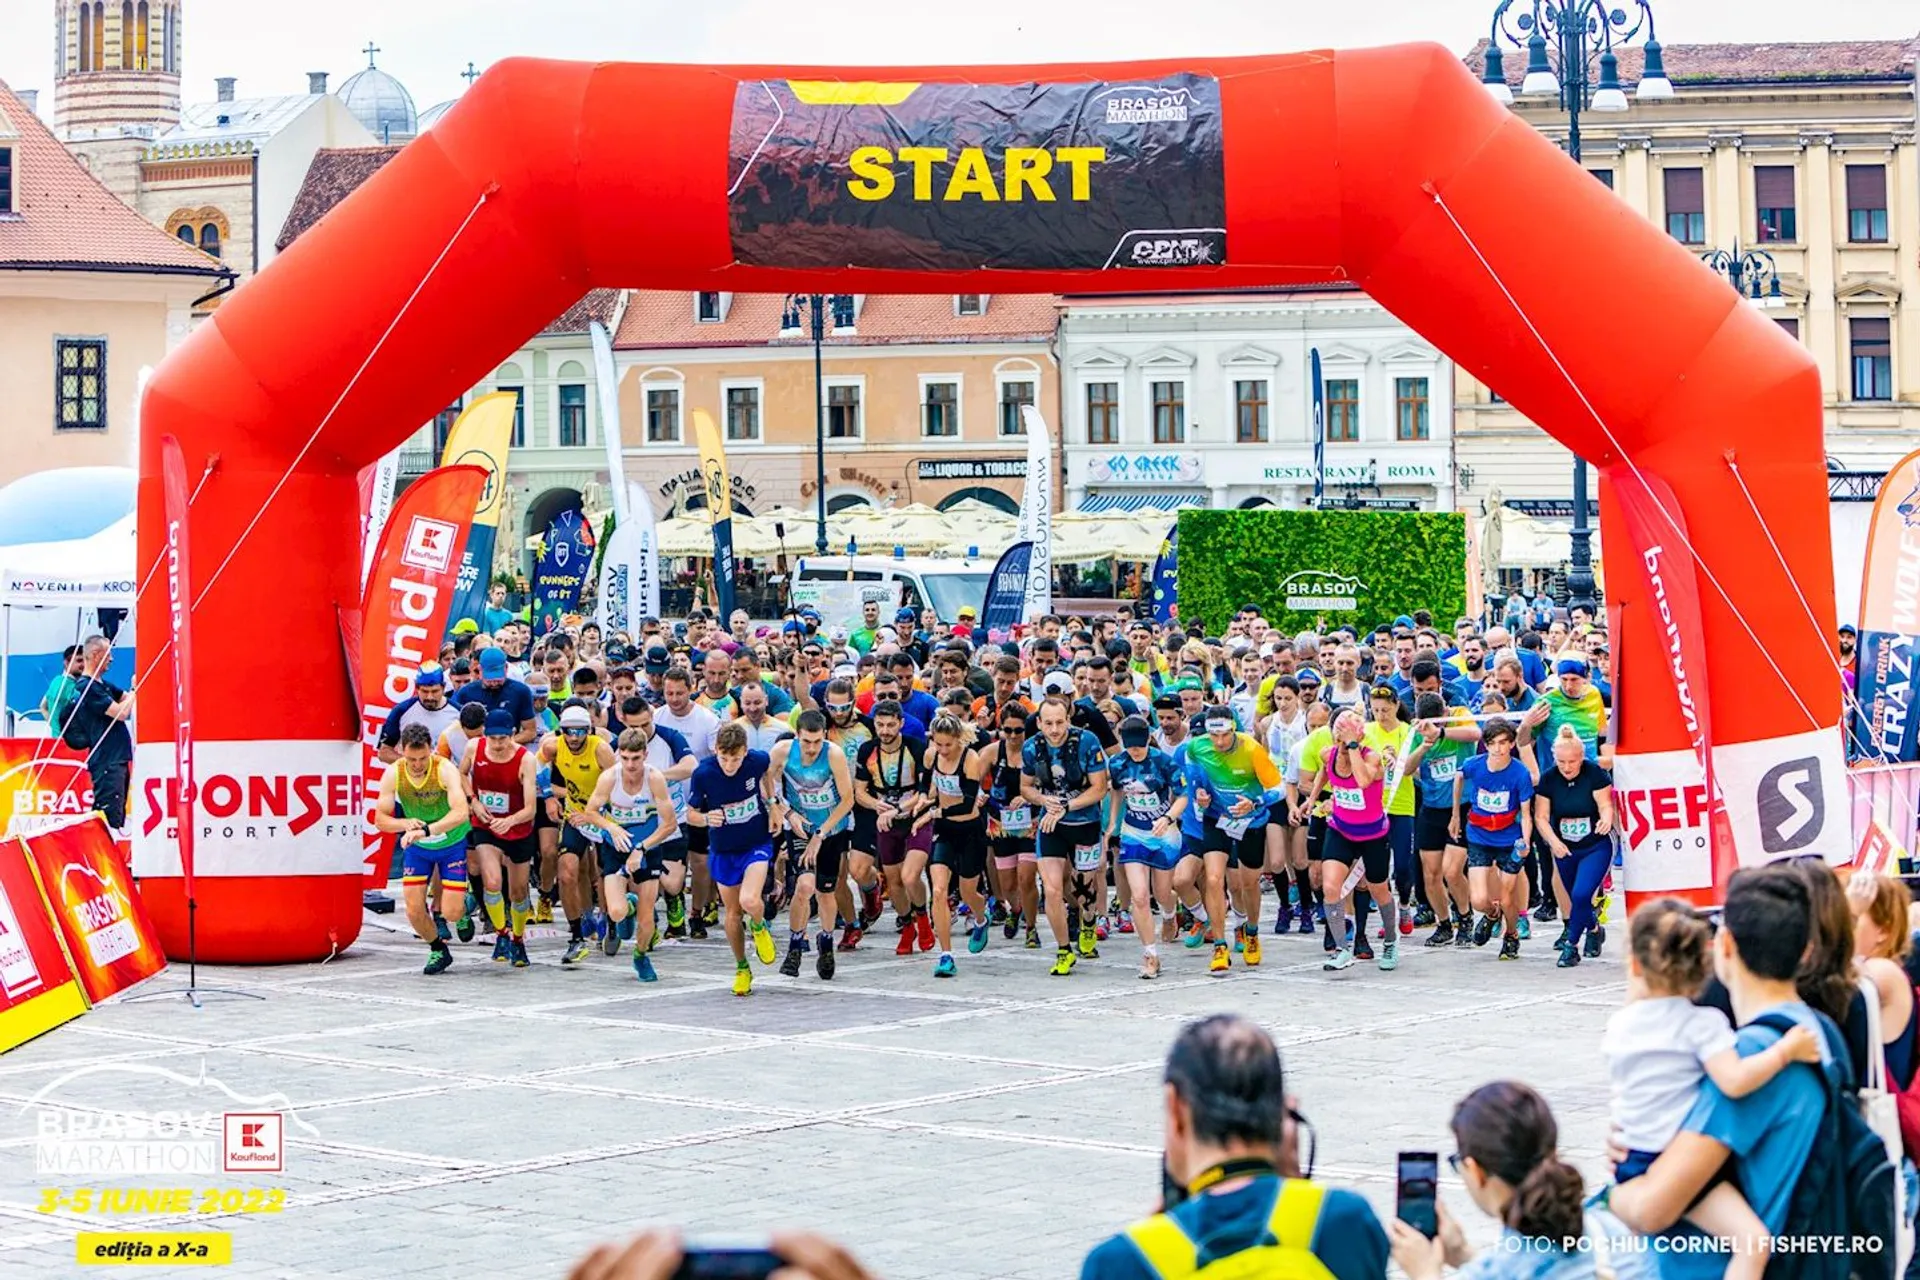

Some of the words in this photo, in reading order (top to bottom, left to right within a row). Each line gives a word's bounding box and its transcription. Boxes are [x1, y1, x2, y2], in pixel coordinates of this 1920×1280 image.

[1107, 94, 1185, 110] BRASOV
[1107, 107, 1187, 122] MARATHON
[847, 146, 1106, 202] START
[1137, 257, 1189, 265] www.cpnt.ro
[935, 462, 974, 478] LIQUOR
[975, 464, 983, 476] &
[984, 461, 1028, 476] TOBACC
[1108, 455, 1128, 472] GO
[1134, 455, 1181, 472] GREEK
[1264, 467, 1367, 479] RESTARANT
[1388, 466, 1436, 477] ROMA
[539, 575, 580, 586] RUNNERS
[1287, 583, 1357, 594] BRASOV
[1289, 598, 1354, 609] MARATHON
[1876, 636, 1892, 684] DRINK
[1881, 632, 1916, 756] CRAZY
[1435, 762, 1454, 775] 167
[12, 789, 95, 814] BRAS
[1336, 790, 1360, 803] 228
[1482, 796, 1502, 807] 84
[615, 809, 641, 817] 241
[727, 801, 755, 818] 370
[1006, 811, 1024, 821] 75
[1562, 822, 1587, 834] 322
[1077, 850, 1100, 862] 175
[74, 891, 123, 932] BRASOV
